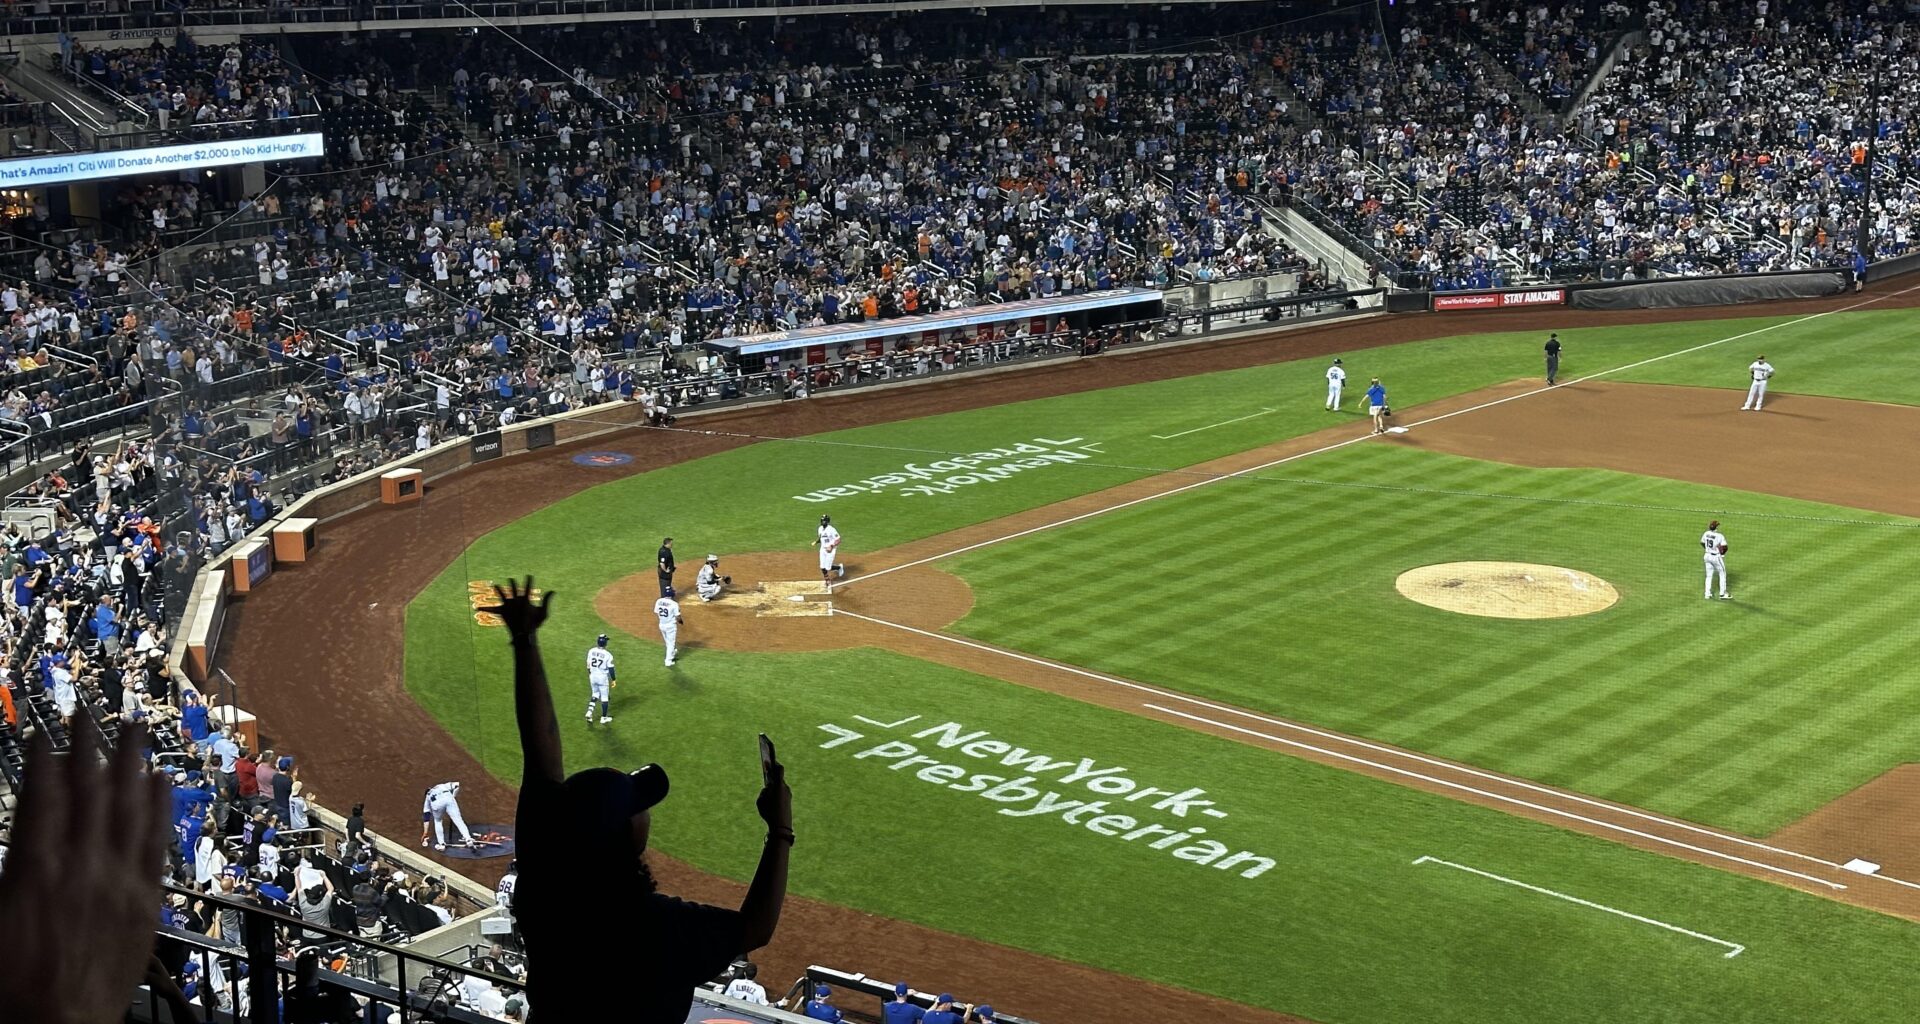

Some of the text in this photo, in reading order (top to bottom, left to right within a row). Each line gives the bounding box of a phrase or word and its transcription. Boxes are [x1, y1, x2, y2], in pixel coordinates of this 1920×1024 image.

[123, 30, 162, 39] HYUNDAI
[0, 142, 307, 179] hat's Amazin'! Citi Will Donate Another $2,000 to No Kid Hungry.
[1504, 291, 1560, 304] STAY AMAZING
[850, 307, 859, 315] 14
[475, 442, 498, 453] verizon
[792, 442, 1050, 503] Presbyterian
[900, 450, 1092, 497] NewYork-
[1706, 539, 1714, 548] 19
[659, 607, 669, 617] 29
[591, 658, 604, 667] 27
[911, 722, 1228, 818] NewYork-
[853, 740, 1277, 879] Presbyterian
